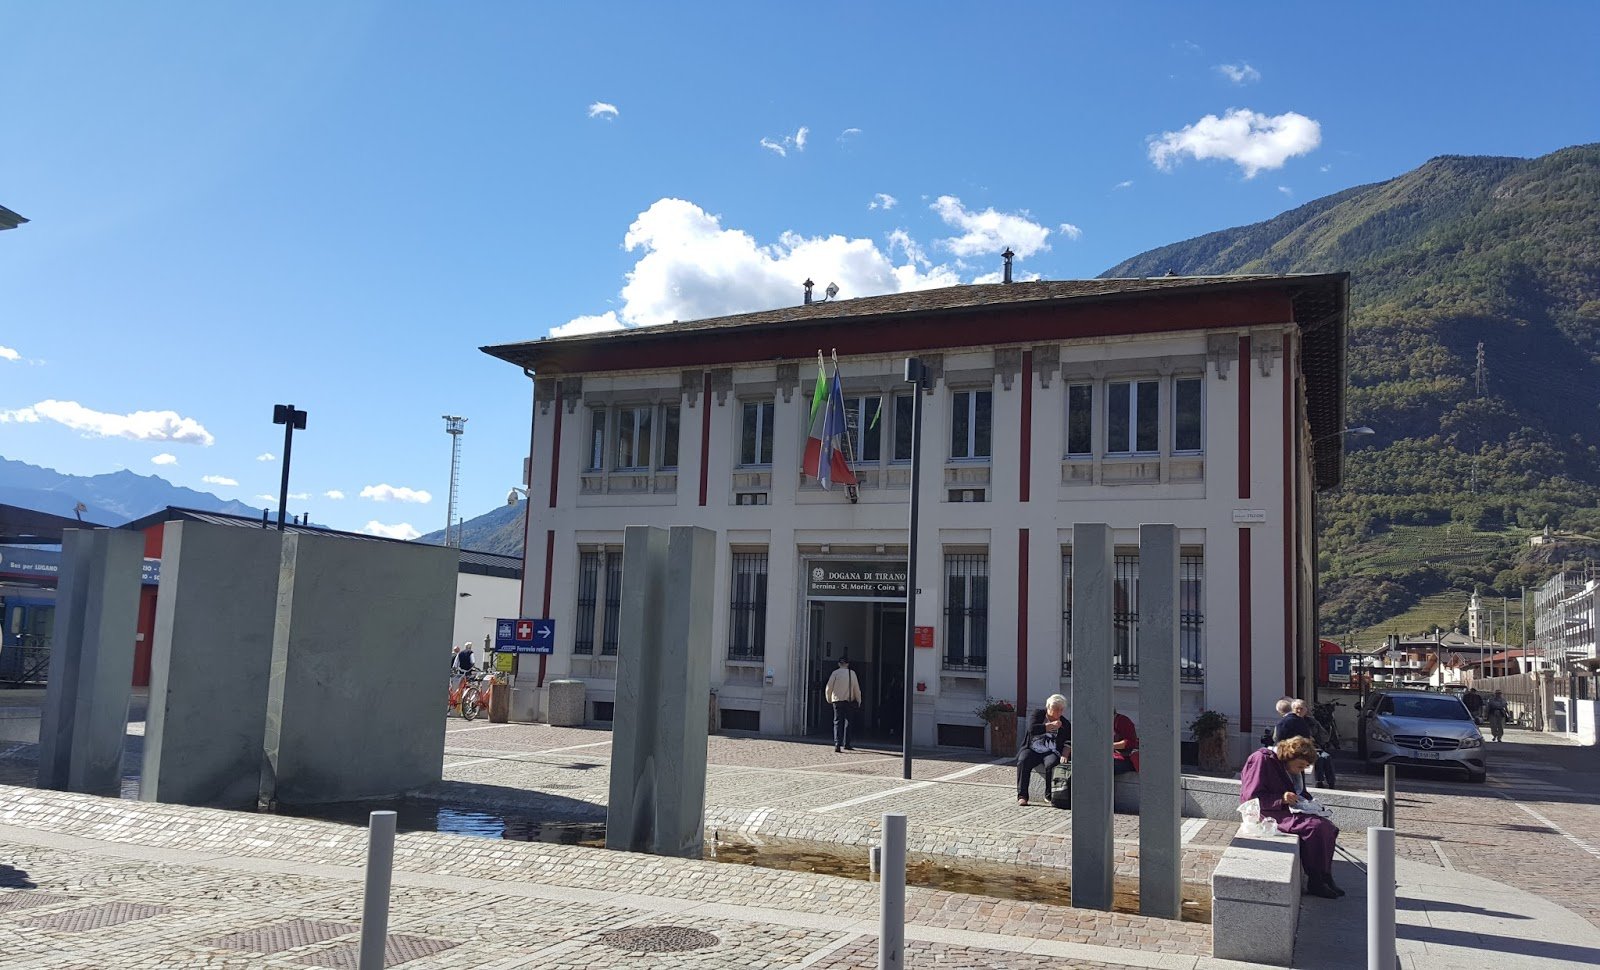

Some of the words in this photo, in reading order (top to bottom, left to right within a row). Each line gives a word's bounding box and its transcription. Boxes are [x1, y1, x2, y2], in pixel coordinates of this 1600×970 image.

[34, 564, 58, 572] LUGANO
[828, 572, 861, 580] DOGANA
[864, 572, 872, 580] DI
[875, 572, 906, 581] TIRANO
[811, 582, 836, 590] Bernina
[850, 583, 872, 591] Moritz
[877, 583, 896, 591] Coira
[1334, 660, 1344, 671] P
